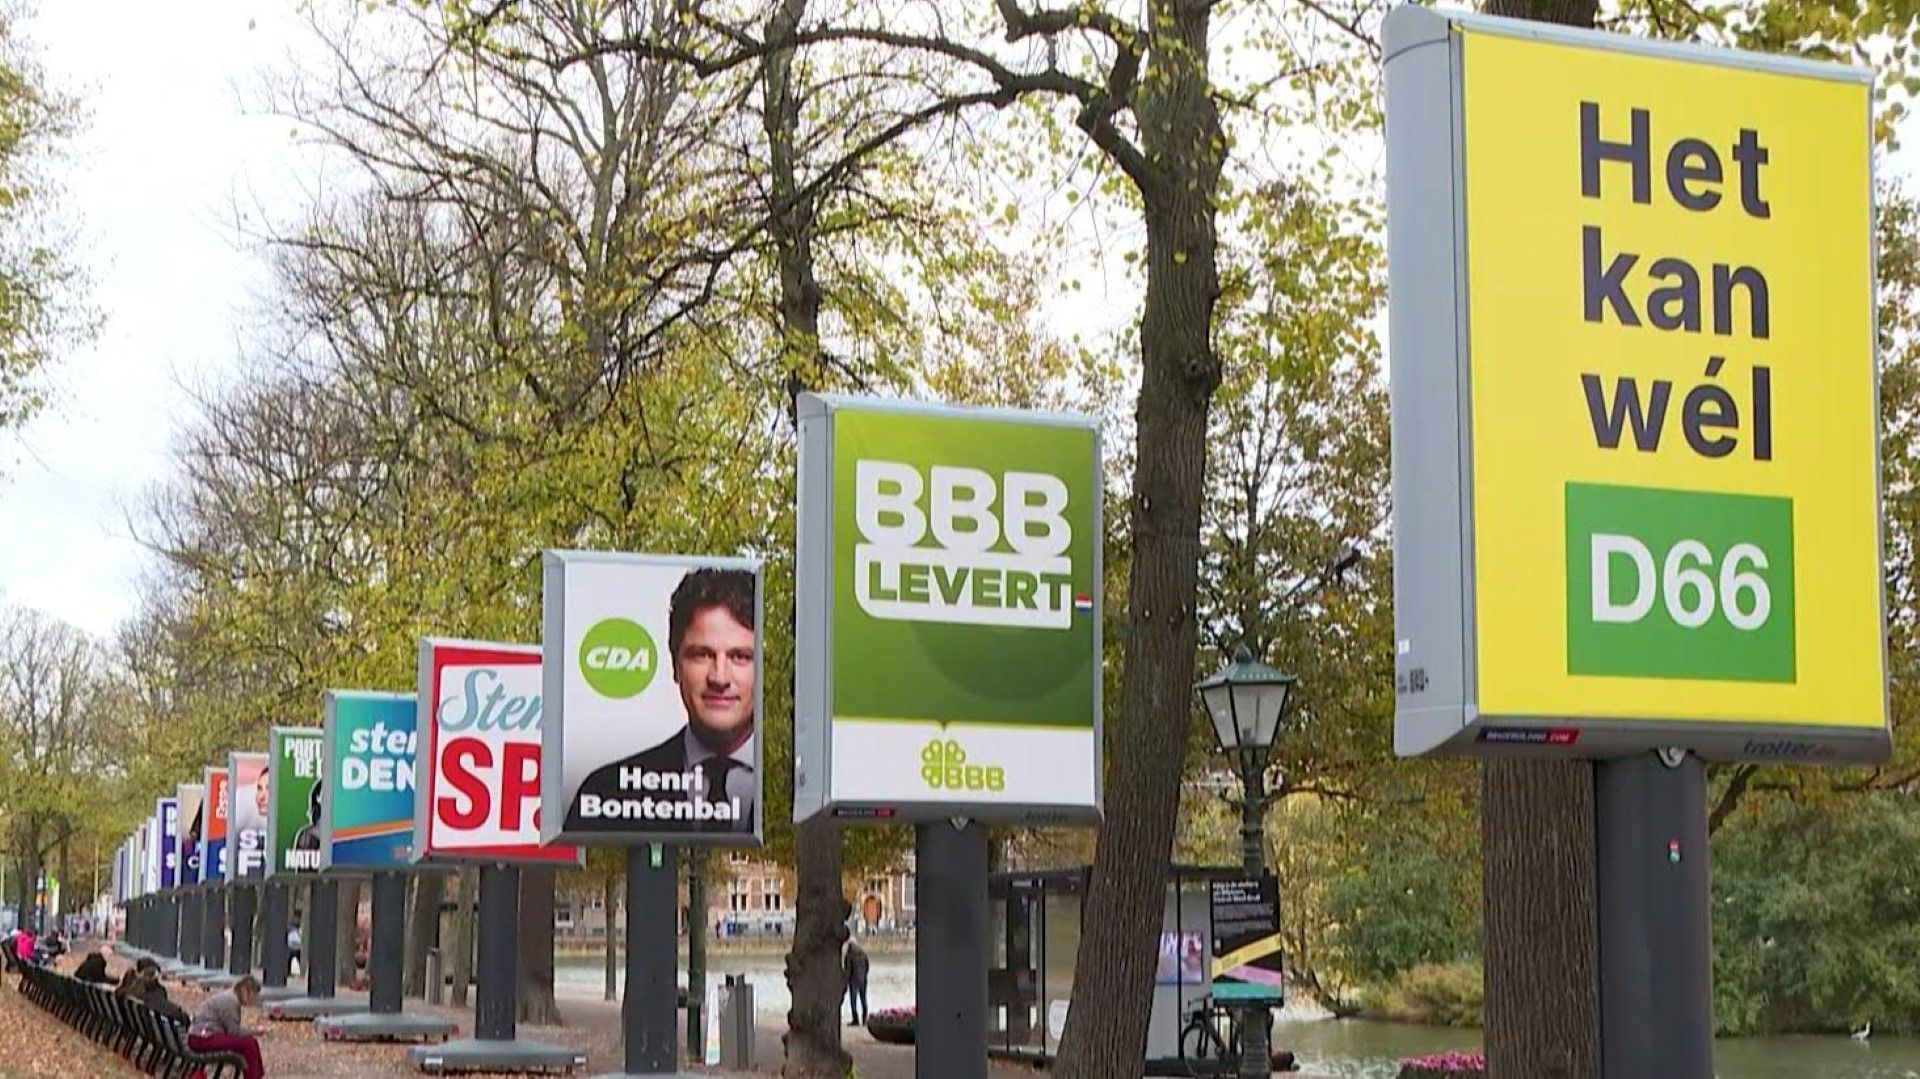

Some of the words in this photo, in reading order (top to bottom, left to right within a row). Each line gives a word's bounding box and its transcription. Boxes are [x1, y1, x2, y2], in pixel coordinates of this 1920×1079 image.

[1580, 101, 1771, 218] Het
[1582, 225, 1770, 339] kan
[1580, 356, 1772, 461] wél
[855, 459, 1072, 557] BBB
[868, 561, 1072, 612] LEVERT
[1591, 533, 1771, 631] D66
[586, 646, 650, 672] CDA
[580, 794, 741, 820] Bontenbal
[619, 765, 704, 791] Henri
[944, 766, 1005, 790] BBB
